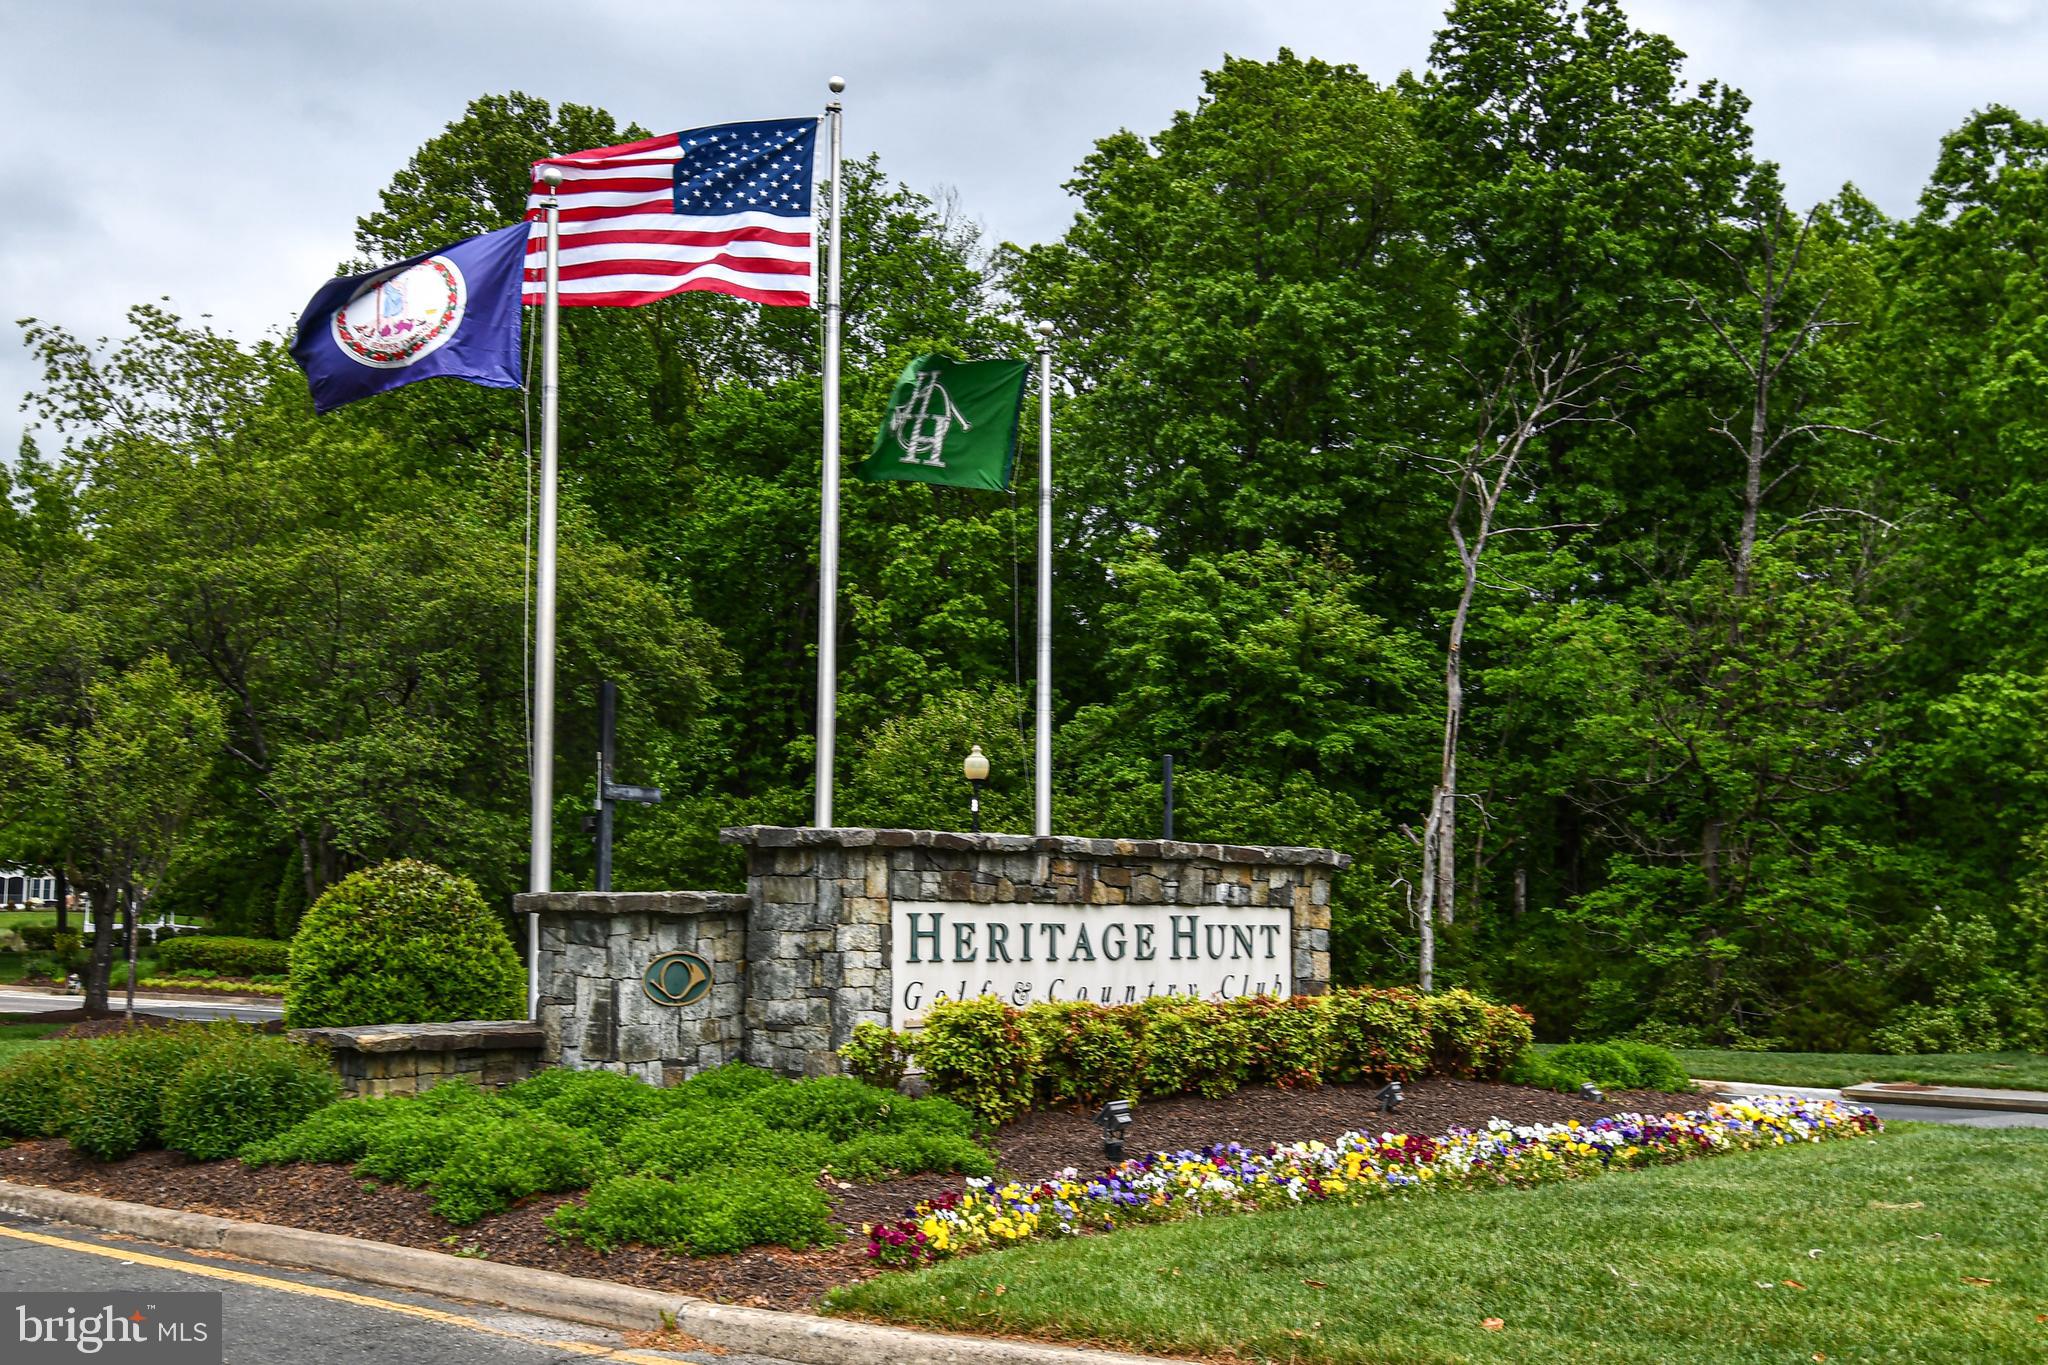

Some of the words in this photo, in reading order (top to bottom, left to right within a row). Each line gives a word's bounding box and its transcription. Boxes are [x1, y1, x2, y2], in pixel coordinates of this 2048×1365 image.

[906, 912, 1156, 964] HERITAGE
[1169, 914, 1281, 960] HUNT
[1012, 981, 1033, 1007] &
[1221, 974, 1282, 999] Club
